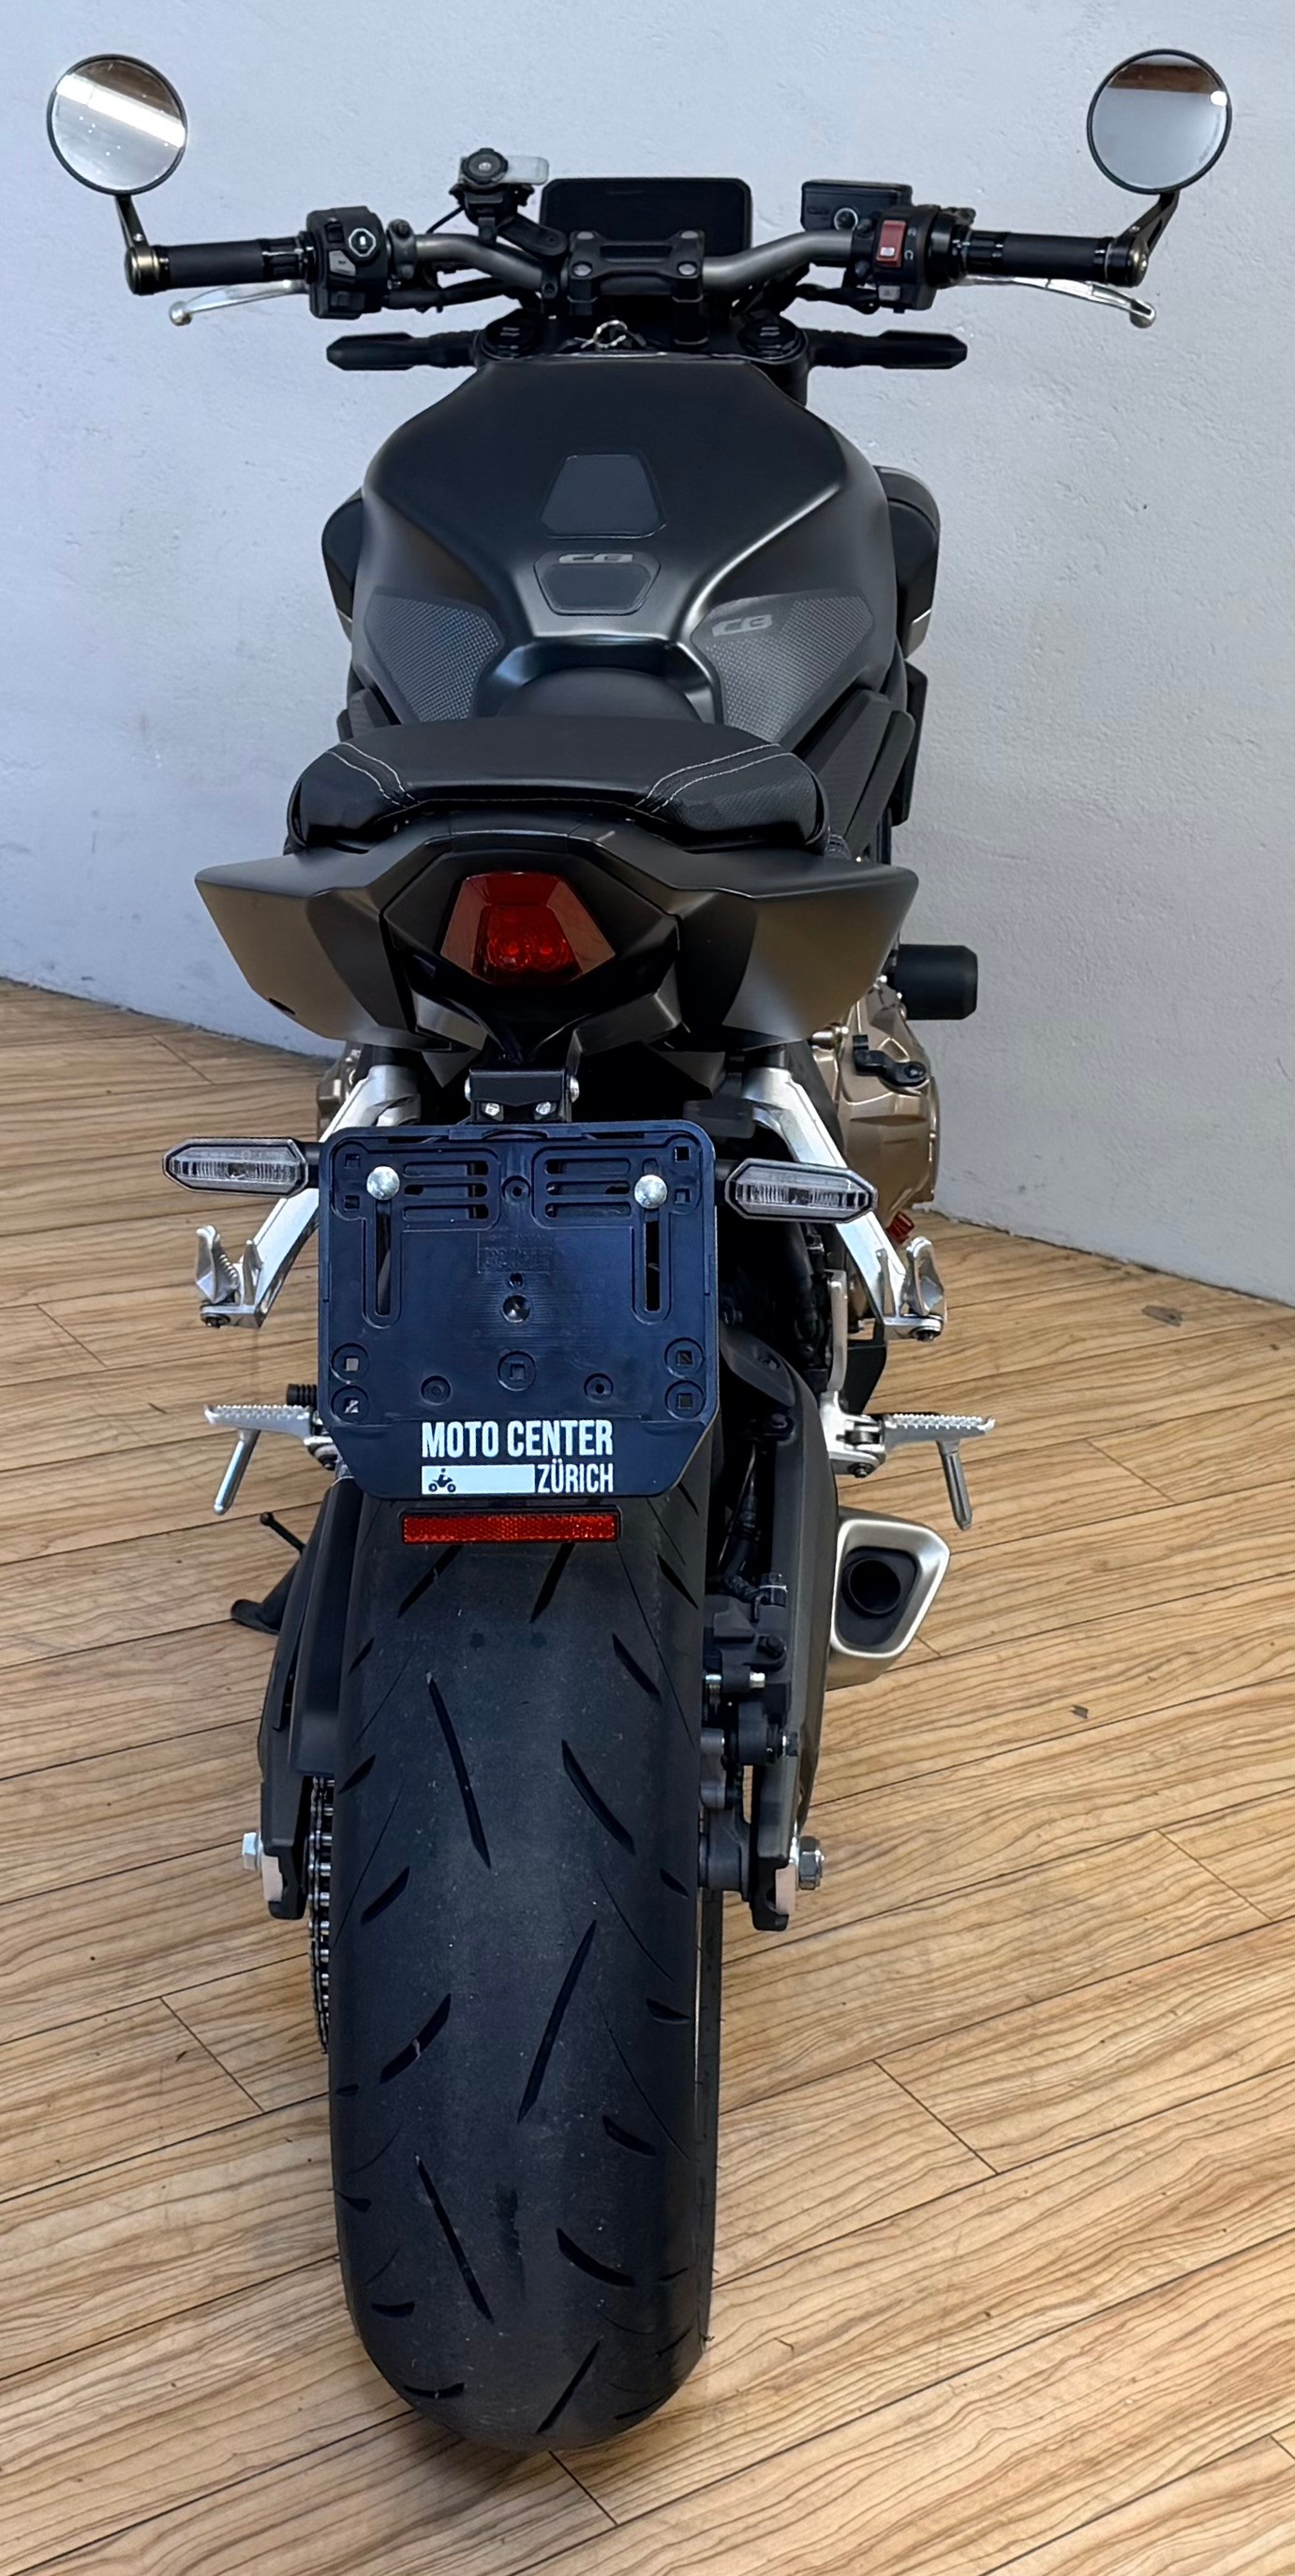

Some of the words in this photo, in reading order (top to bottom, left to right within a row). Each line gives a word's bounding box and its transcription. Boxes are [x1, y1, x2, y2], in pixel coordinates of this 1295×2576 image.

[711, 613, 773, 637] CB
[422, 1420, 499, 1458] MOTO
[507, 1419, 614, 1457] CENTER
[537, 1458, 614, 1493] ZÜRICH
